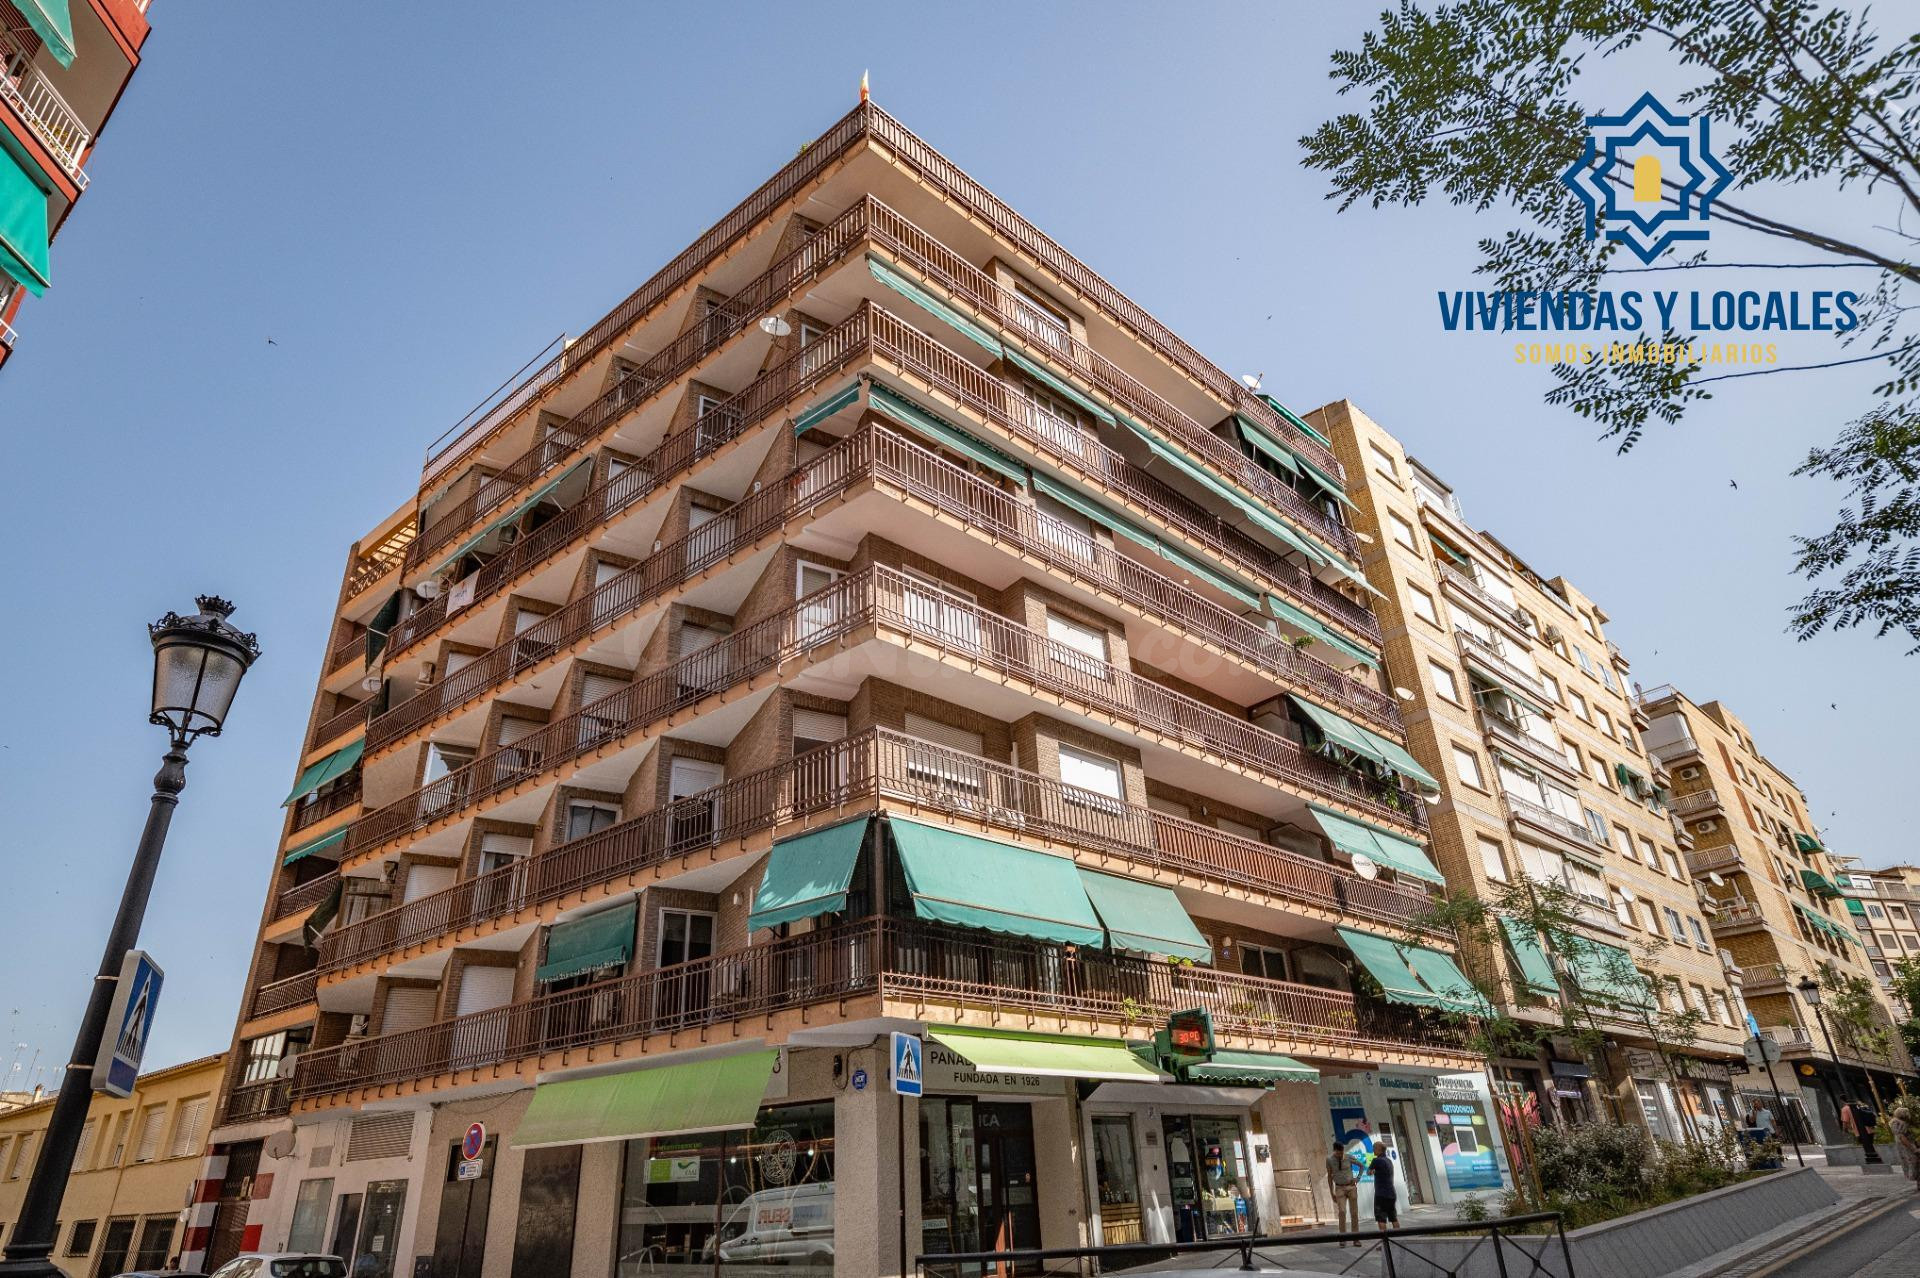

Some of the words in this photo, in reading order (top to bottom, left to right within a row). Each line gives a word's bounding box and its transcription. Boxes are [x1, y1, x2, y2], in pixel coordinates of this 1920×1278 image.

[954, 1072, 999, 1084] FUNDADA
[1004, 1075, 1017, 1085] EN
[1022, 1076, 1040, 1087] 1926
